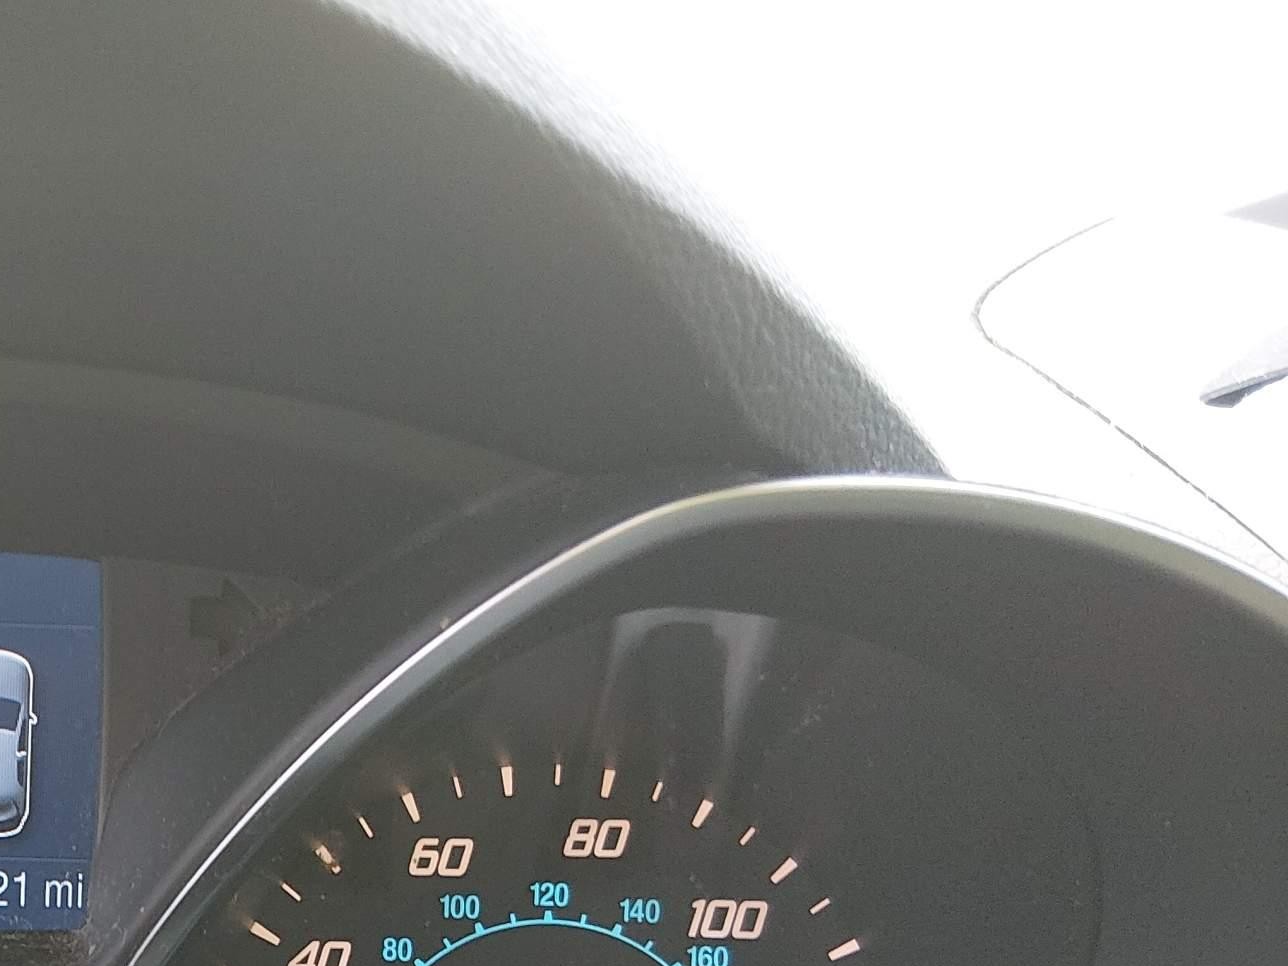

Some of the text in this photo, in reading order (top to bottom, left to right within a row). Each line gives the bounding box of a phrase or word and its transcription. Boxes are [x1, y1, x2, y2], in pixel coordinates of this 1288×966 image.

[563, 819, 630, 858] 80
[408, 839, 473, 877] 60
[45, 873, 84, 907] mi
[530, 883, 569, 906] 120
[440, 895, 480, 919] 100
[620, 900, 661, 923] 140
[688, 900, 767, 939] 100
[382, 938, 412, 961] 80
